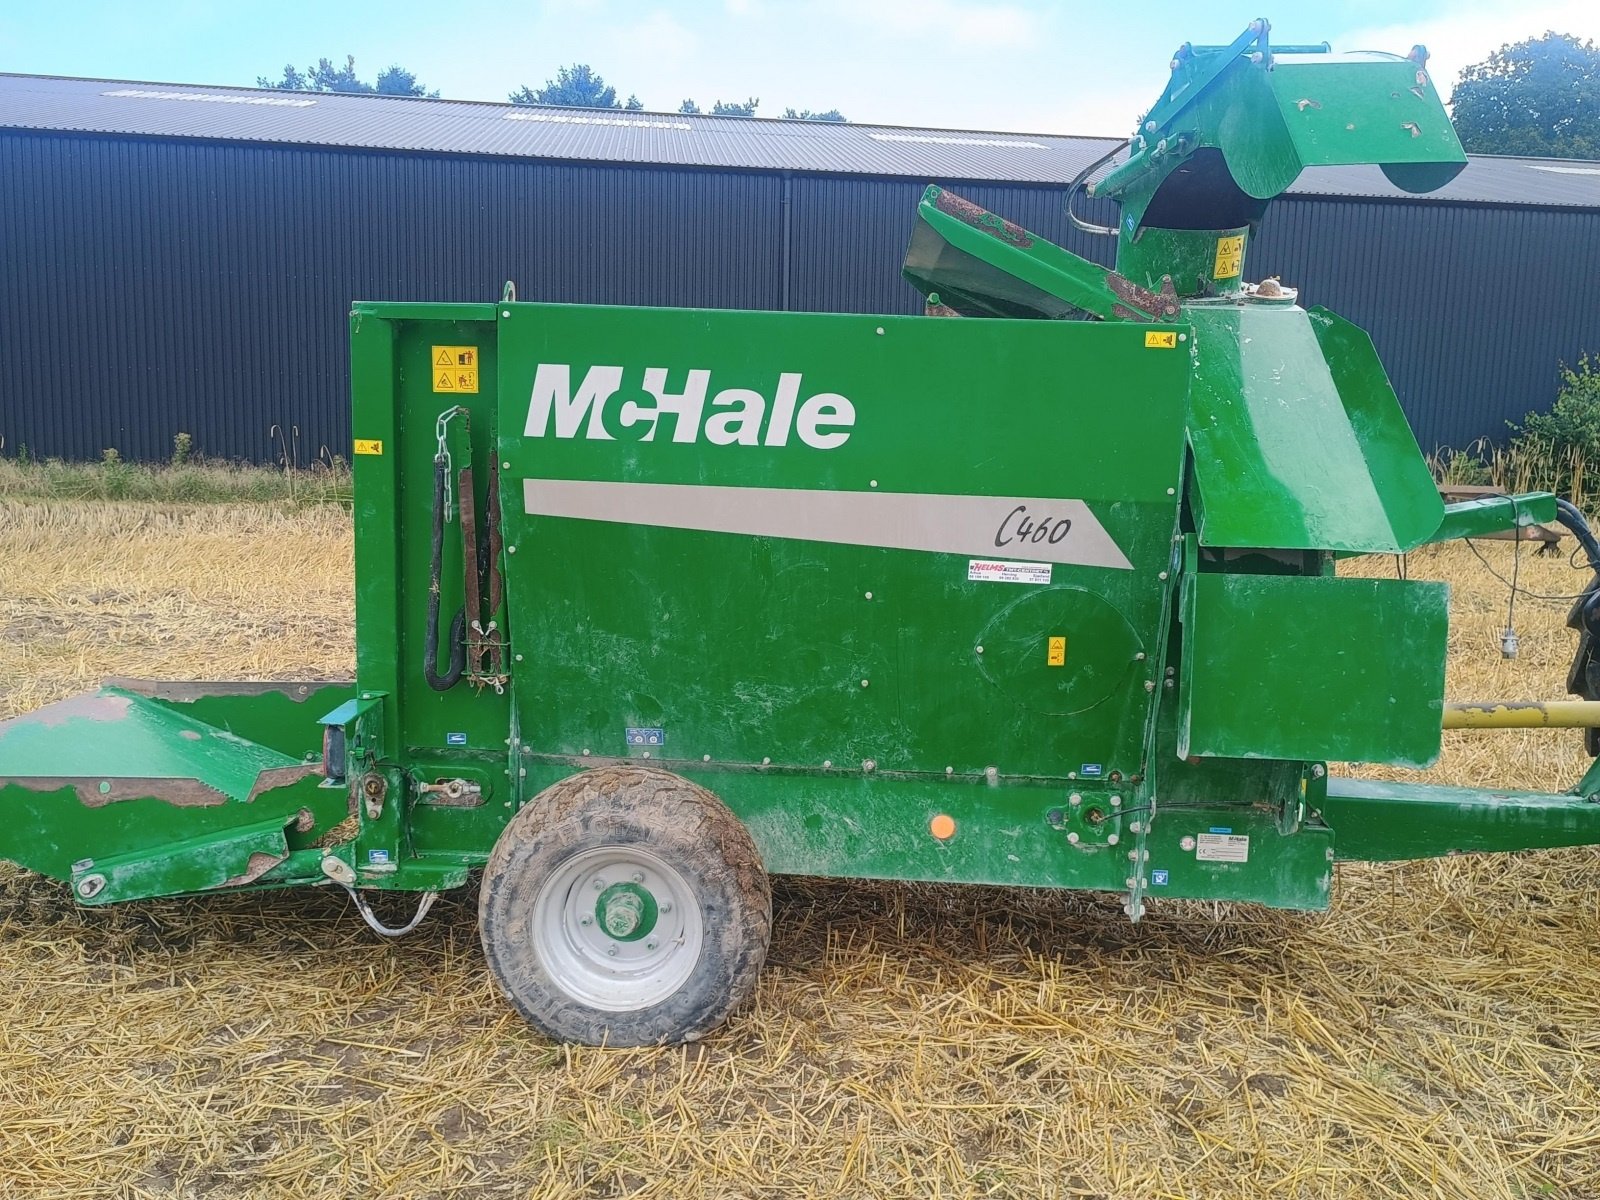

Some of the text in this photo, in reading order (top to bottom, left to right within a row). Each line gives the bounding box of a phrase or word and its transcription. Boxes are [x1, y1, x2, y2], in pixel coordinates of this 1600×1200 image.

[523, 363, 856, 450] McHale
[994, 505, 1072, 548] C460
[973, 563, 1005, 571] HELMS
